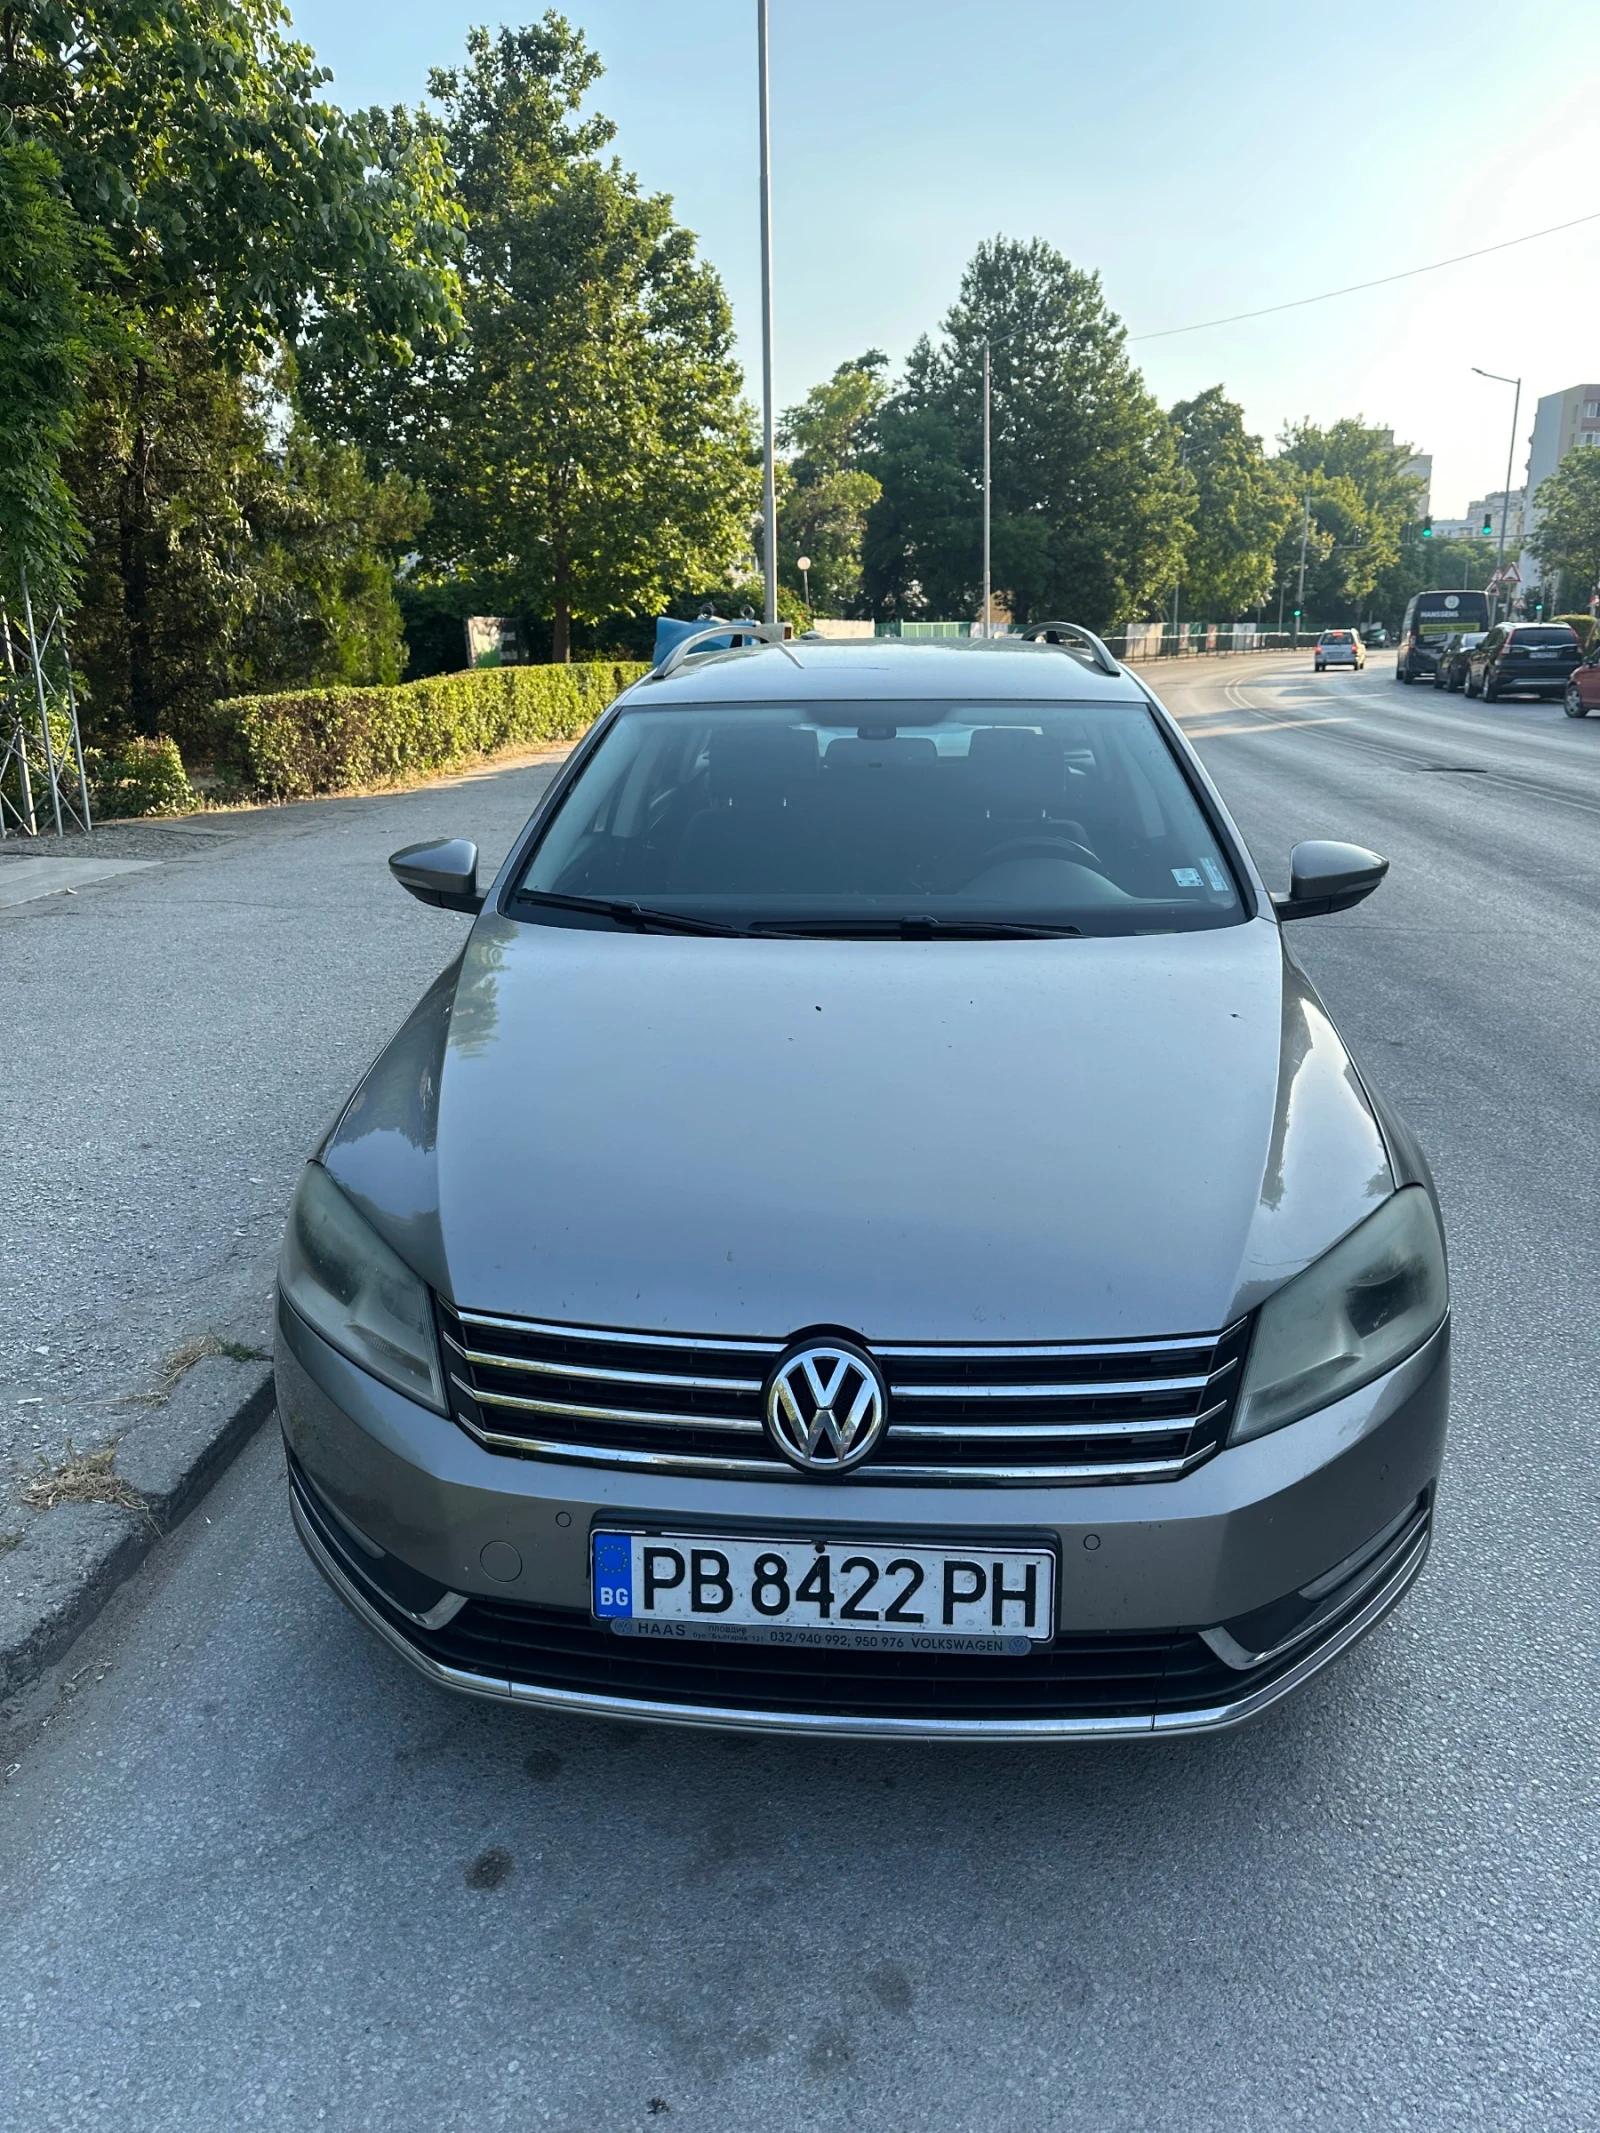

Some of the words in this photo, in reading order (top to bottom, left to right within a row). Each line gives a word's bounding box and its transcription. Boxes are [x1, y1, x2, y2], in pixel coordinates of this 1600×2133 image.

[600, 1586, 629, 1606] BG
[643, 1547, 733, 1614] PB
[751, 1552, 925, 1623] 8422
[942, 1559, 1037, 1628] PH
[637, 1622, 686, 1637] HAAS
[769, 1631, 822, 1644] 032/940
[855, 1636, 878, 1647] 950
[881, 1637, 904, 1648] 976
[911, 1637, 1003, 1651] VOLKSWAGEN
